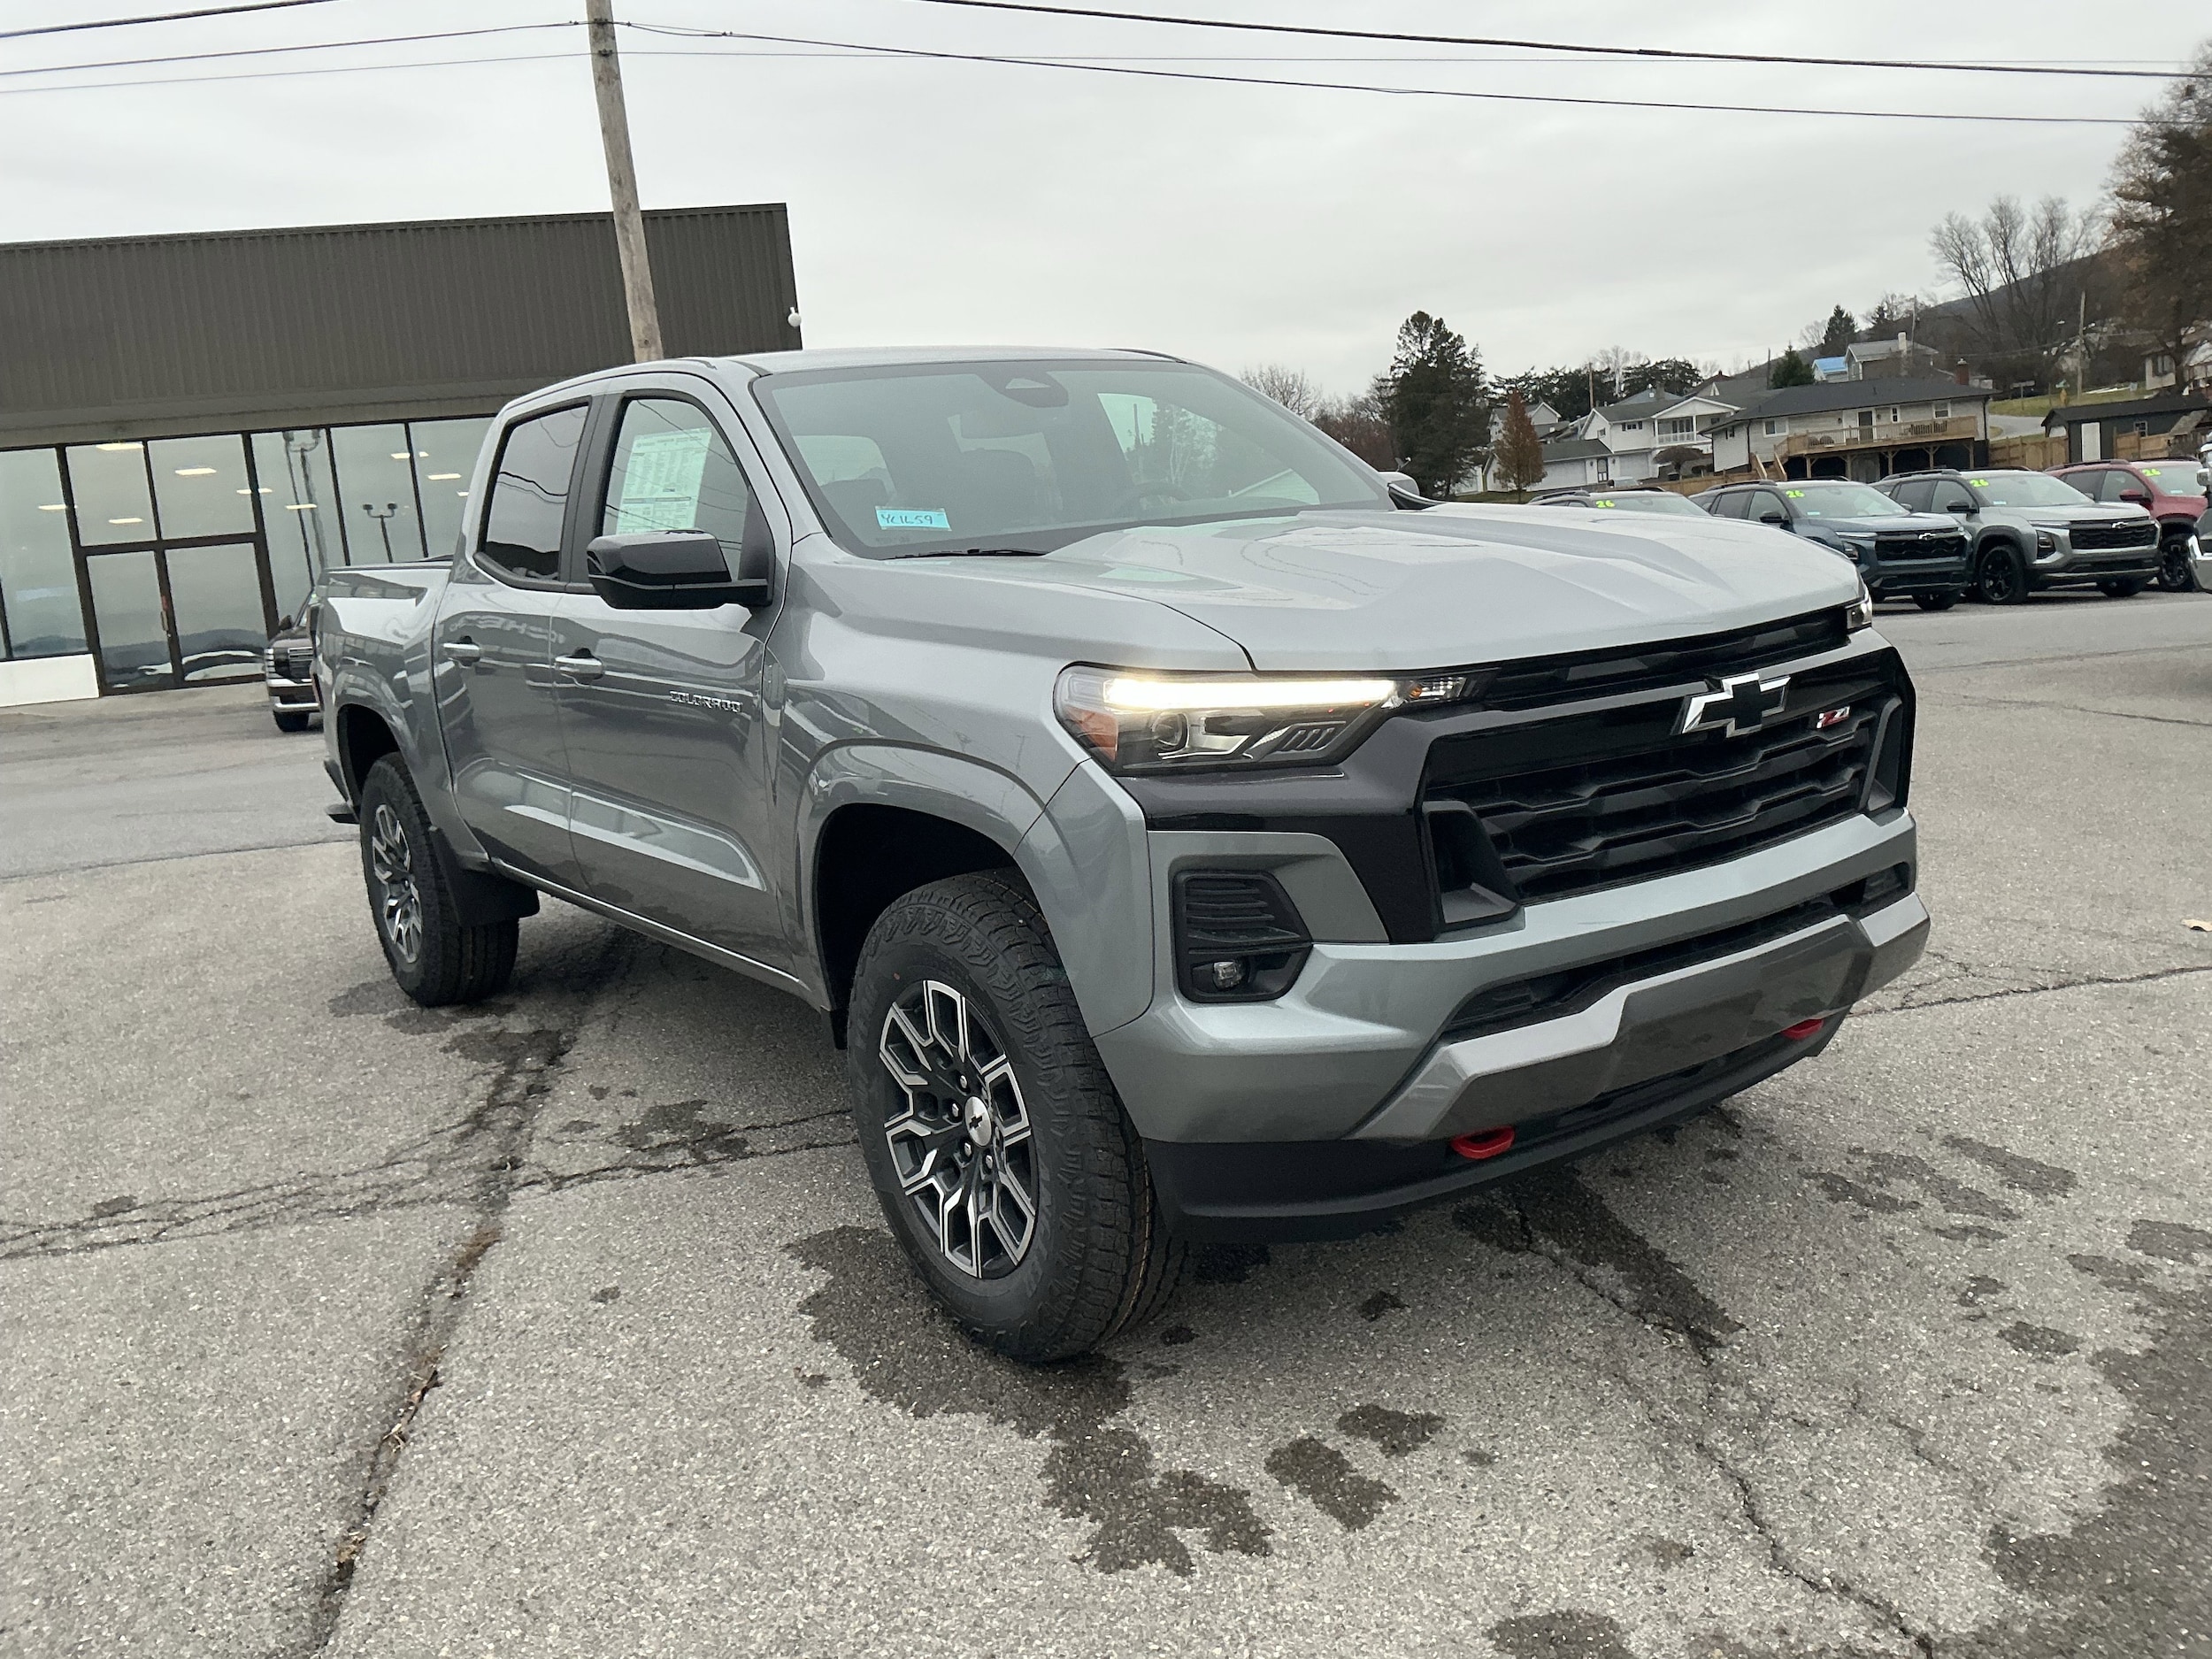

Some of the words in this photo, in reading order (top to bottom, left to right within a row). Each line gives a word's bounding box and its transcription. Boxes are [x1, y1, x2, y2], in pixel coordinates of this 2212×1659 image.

[1785, 489, 1805, 498] 26
[1595, 499, 1616, 508] 26
[670, 690, 743, 713] COLORADO
